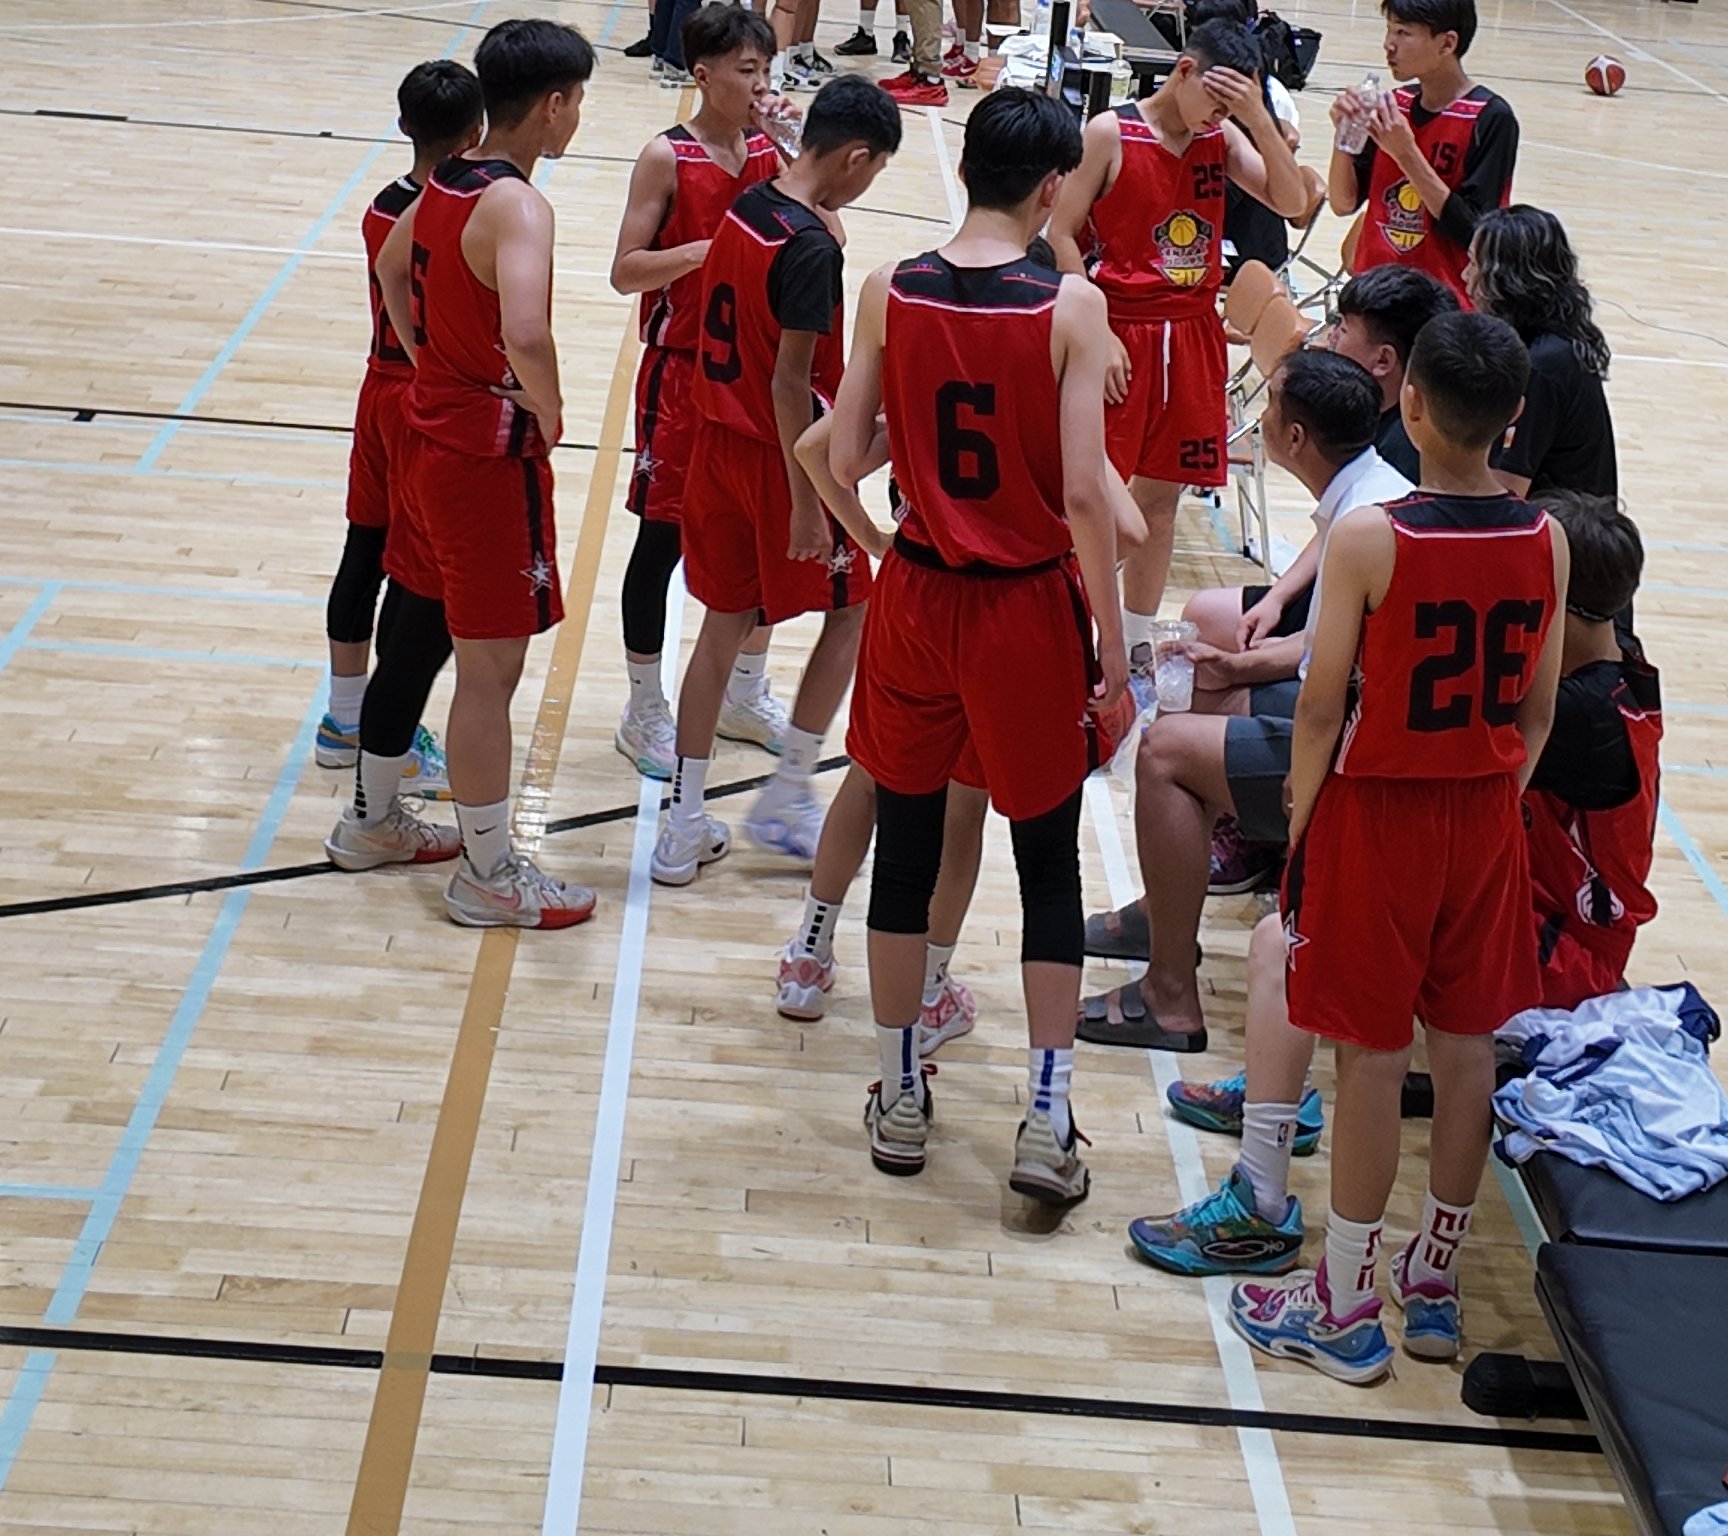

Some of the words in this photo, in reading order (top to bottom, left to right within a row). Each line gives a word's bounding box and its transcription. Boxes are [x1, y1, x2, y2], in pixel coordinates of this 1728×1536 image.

[1191, 163, 1223, 200] 25
[704, 282, 742, 384] 9
[936, 380, 1000, 500] 6
[1180, 438, 1219, 469] 25
[1407, 599, 1545, 732] 26
